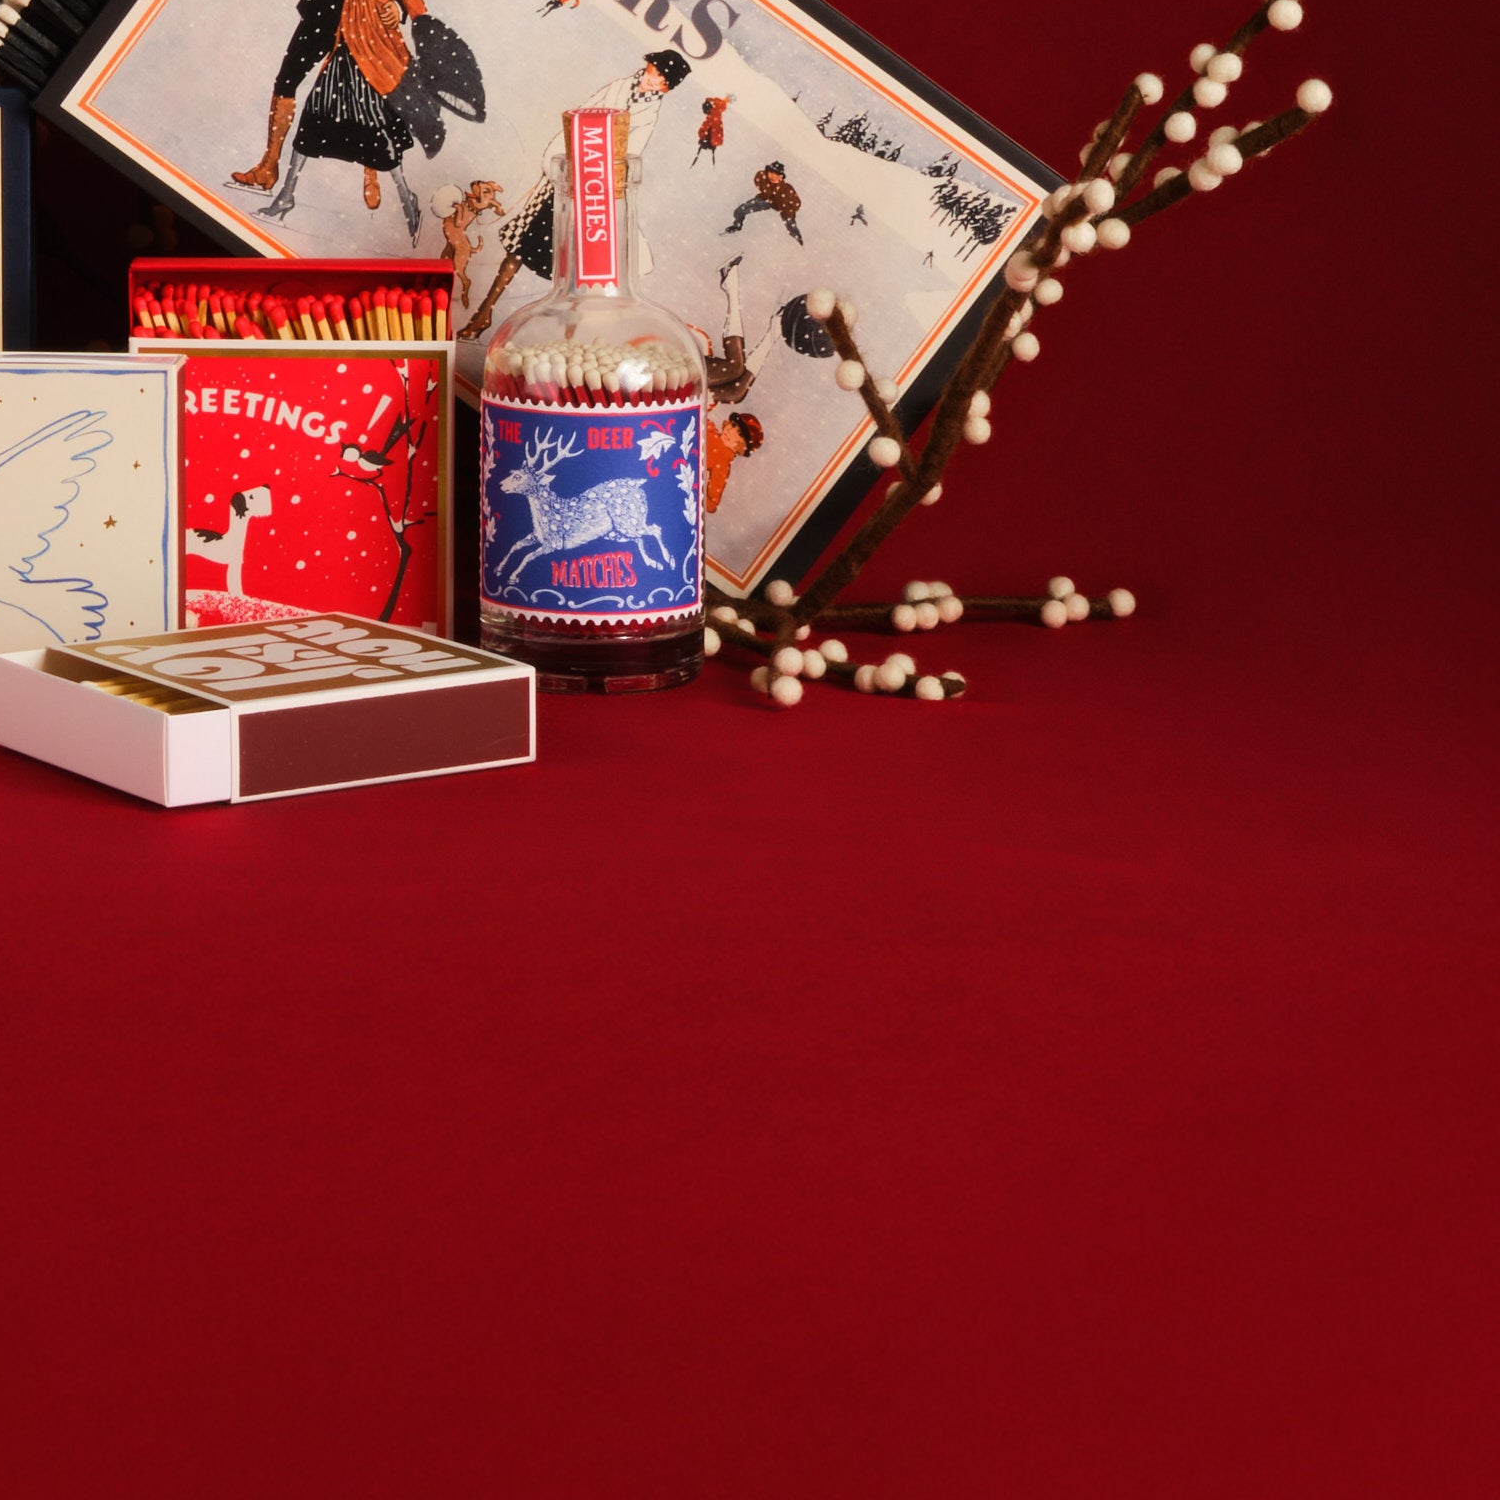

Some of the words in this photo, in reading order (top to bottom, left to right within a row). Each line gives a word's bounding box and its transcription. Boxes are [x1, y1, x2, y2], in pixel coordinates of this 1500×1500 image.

[582, 126, 607, 243] MATCHES
[185, 387, 393, 445] REETINGS!
[498, 419, 523, 445] THE
[586, 426, 635, 450] DEER
[551, 551, 638, 588] MATCHES
